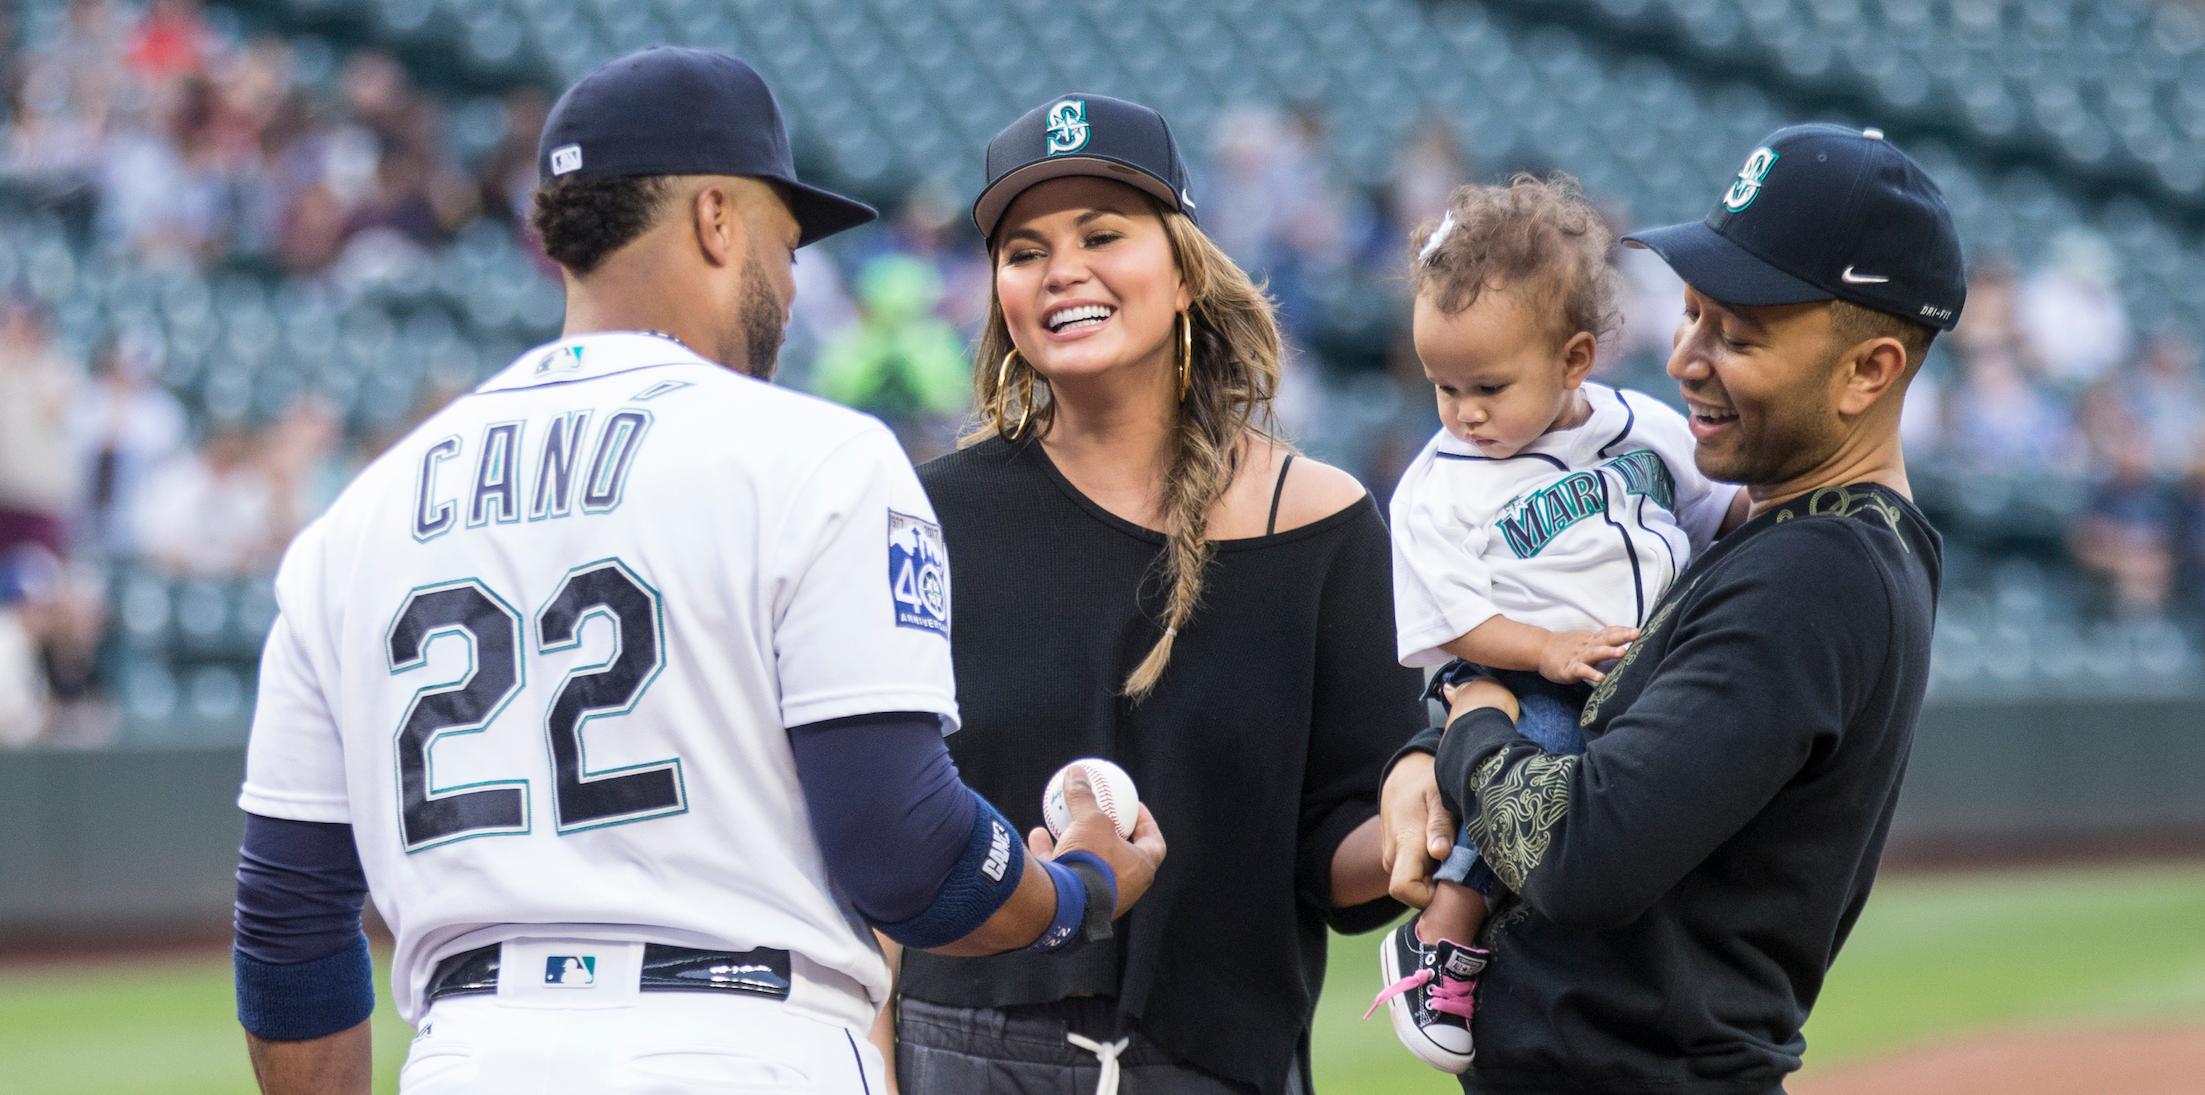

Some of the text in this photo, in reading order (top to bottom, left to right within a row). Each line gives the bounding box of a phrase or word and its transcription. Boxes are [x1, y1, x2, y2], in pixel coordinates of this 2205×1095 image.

[1046, 98, 1090, 159] S
[1723, 146, 1781, 212] S
[1920, 305, 1952, 320] DRI-FIT
[385, 556, 689, 856] 22
